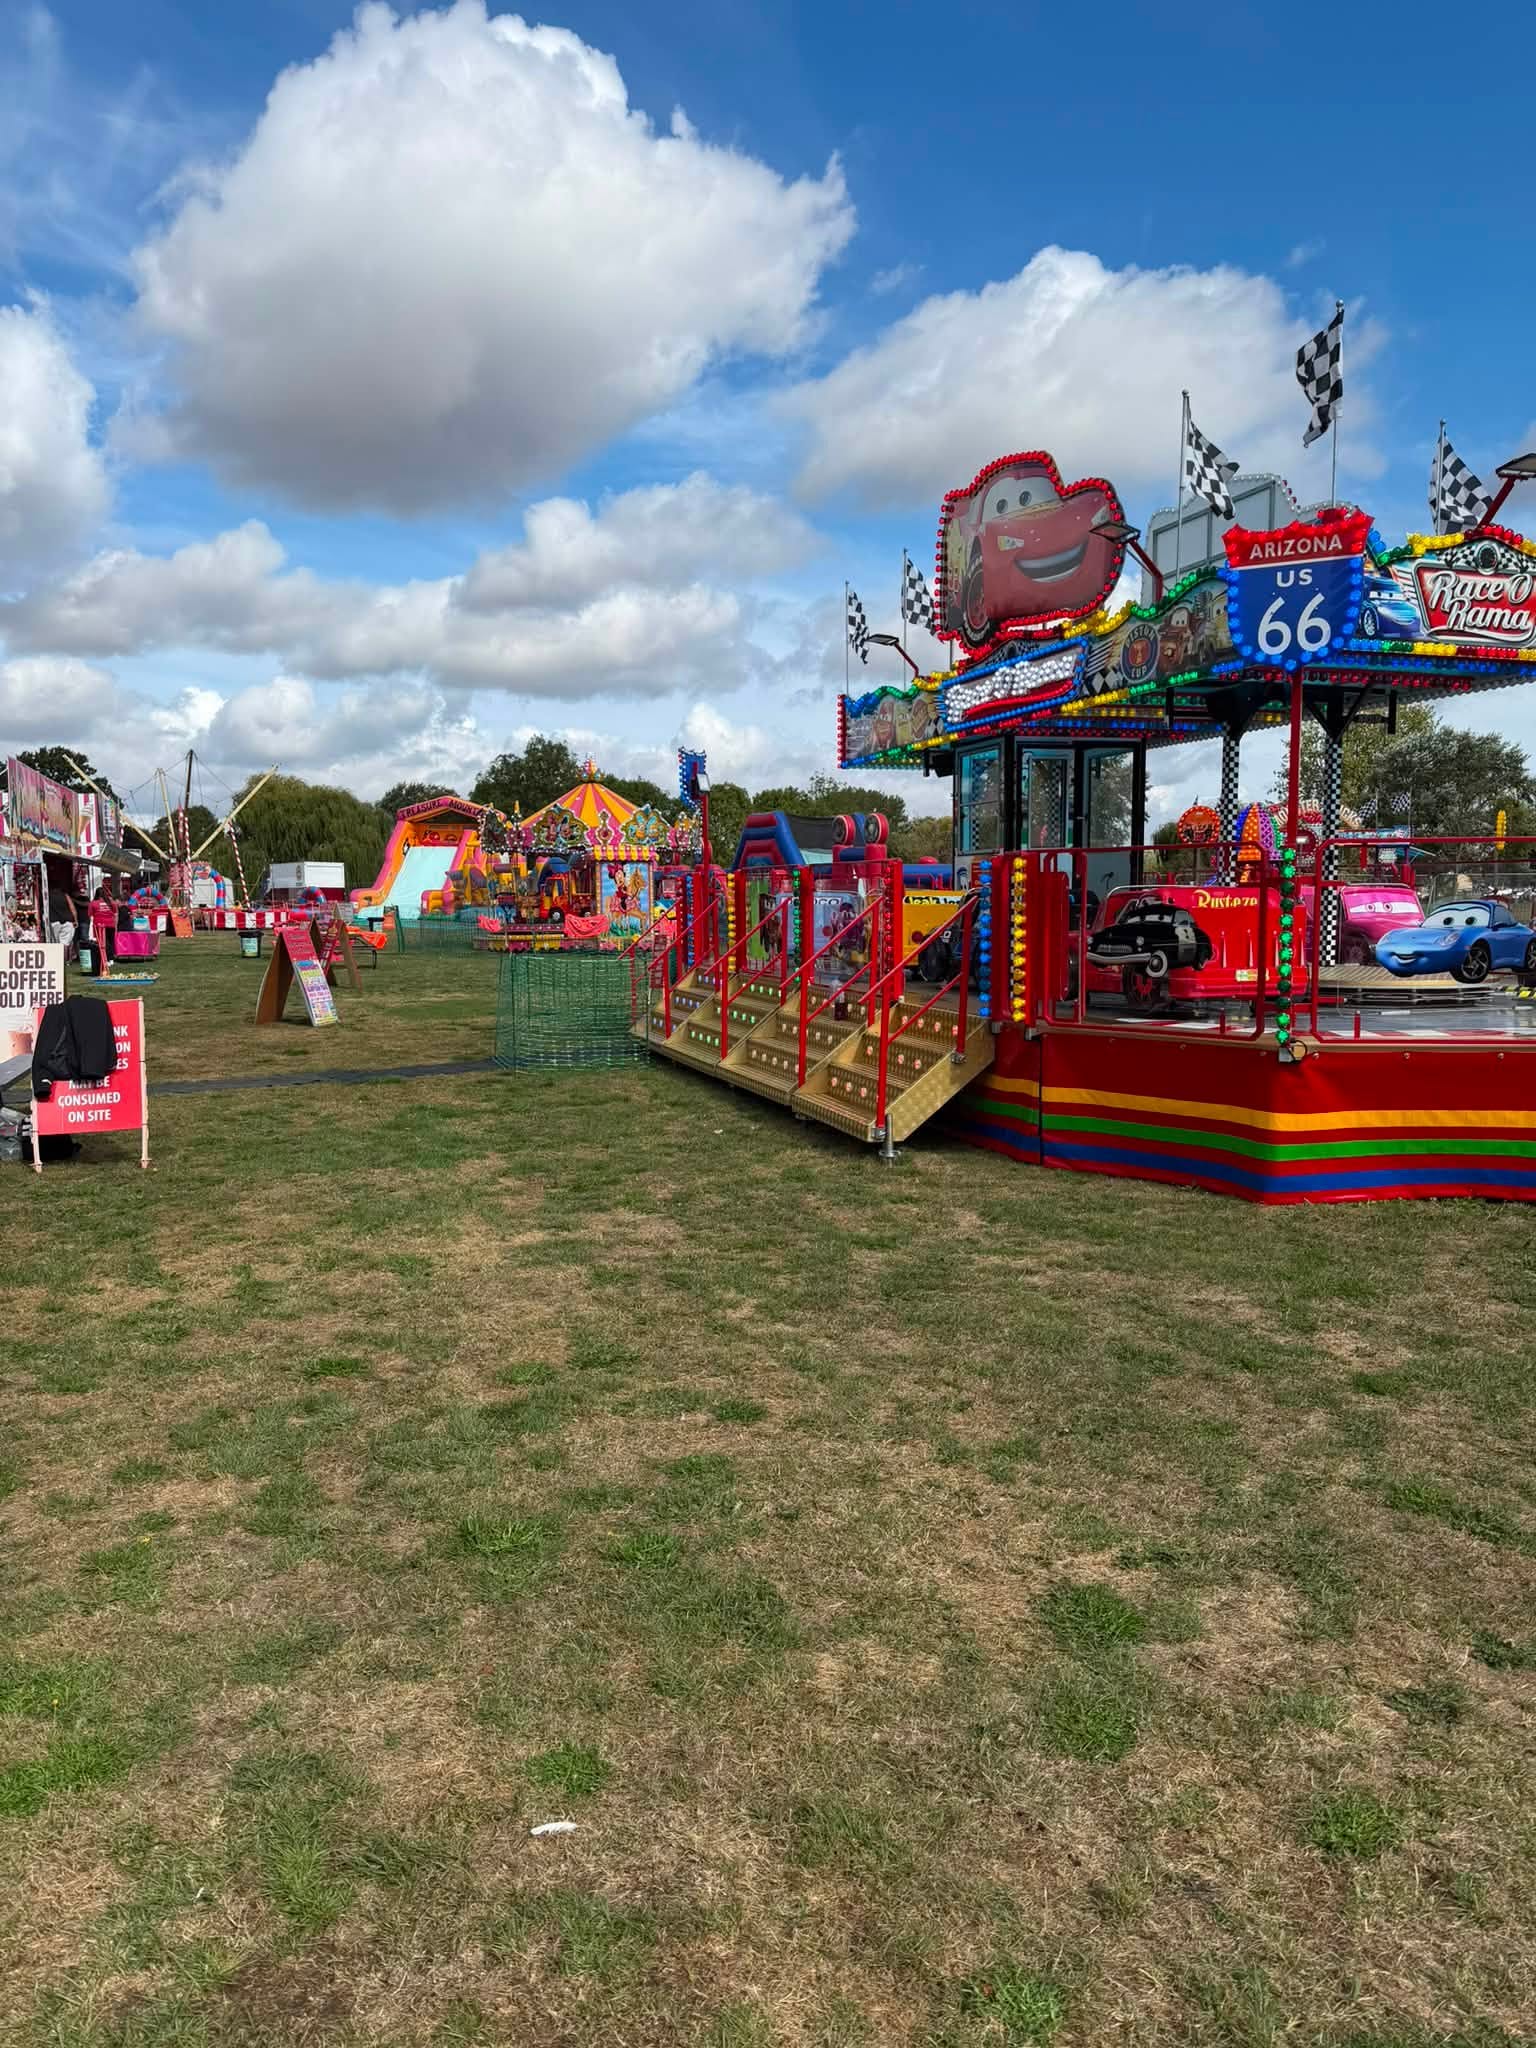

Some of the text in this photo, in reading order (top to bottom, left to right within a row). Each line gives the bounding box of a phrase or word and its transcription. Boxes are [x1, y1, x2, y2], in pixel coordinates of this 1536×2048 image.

[1249, 534, 1342, 560] ARIZONA
[1276, 569, 1313, 588] US
[1428, 570, 1533, 612] Race O
[1257, 592, 1331, 655] 66
[1446, 597, 1531, 631] Rama
[1131, 664, 1147, 678] CUP
[398, 799, 484, 820] TREASURE MOUNTA
[9, 950, 45, 969] ICED
[0, 970, 57, 990] COFFEE
[0, 991, 63, 1008] OLD HERE
[96, 1075, 110, 1088] BE
[58, 1091, 121, 1107] CONSUMED
[68, 1109, 112, 1123] ON SITE
